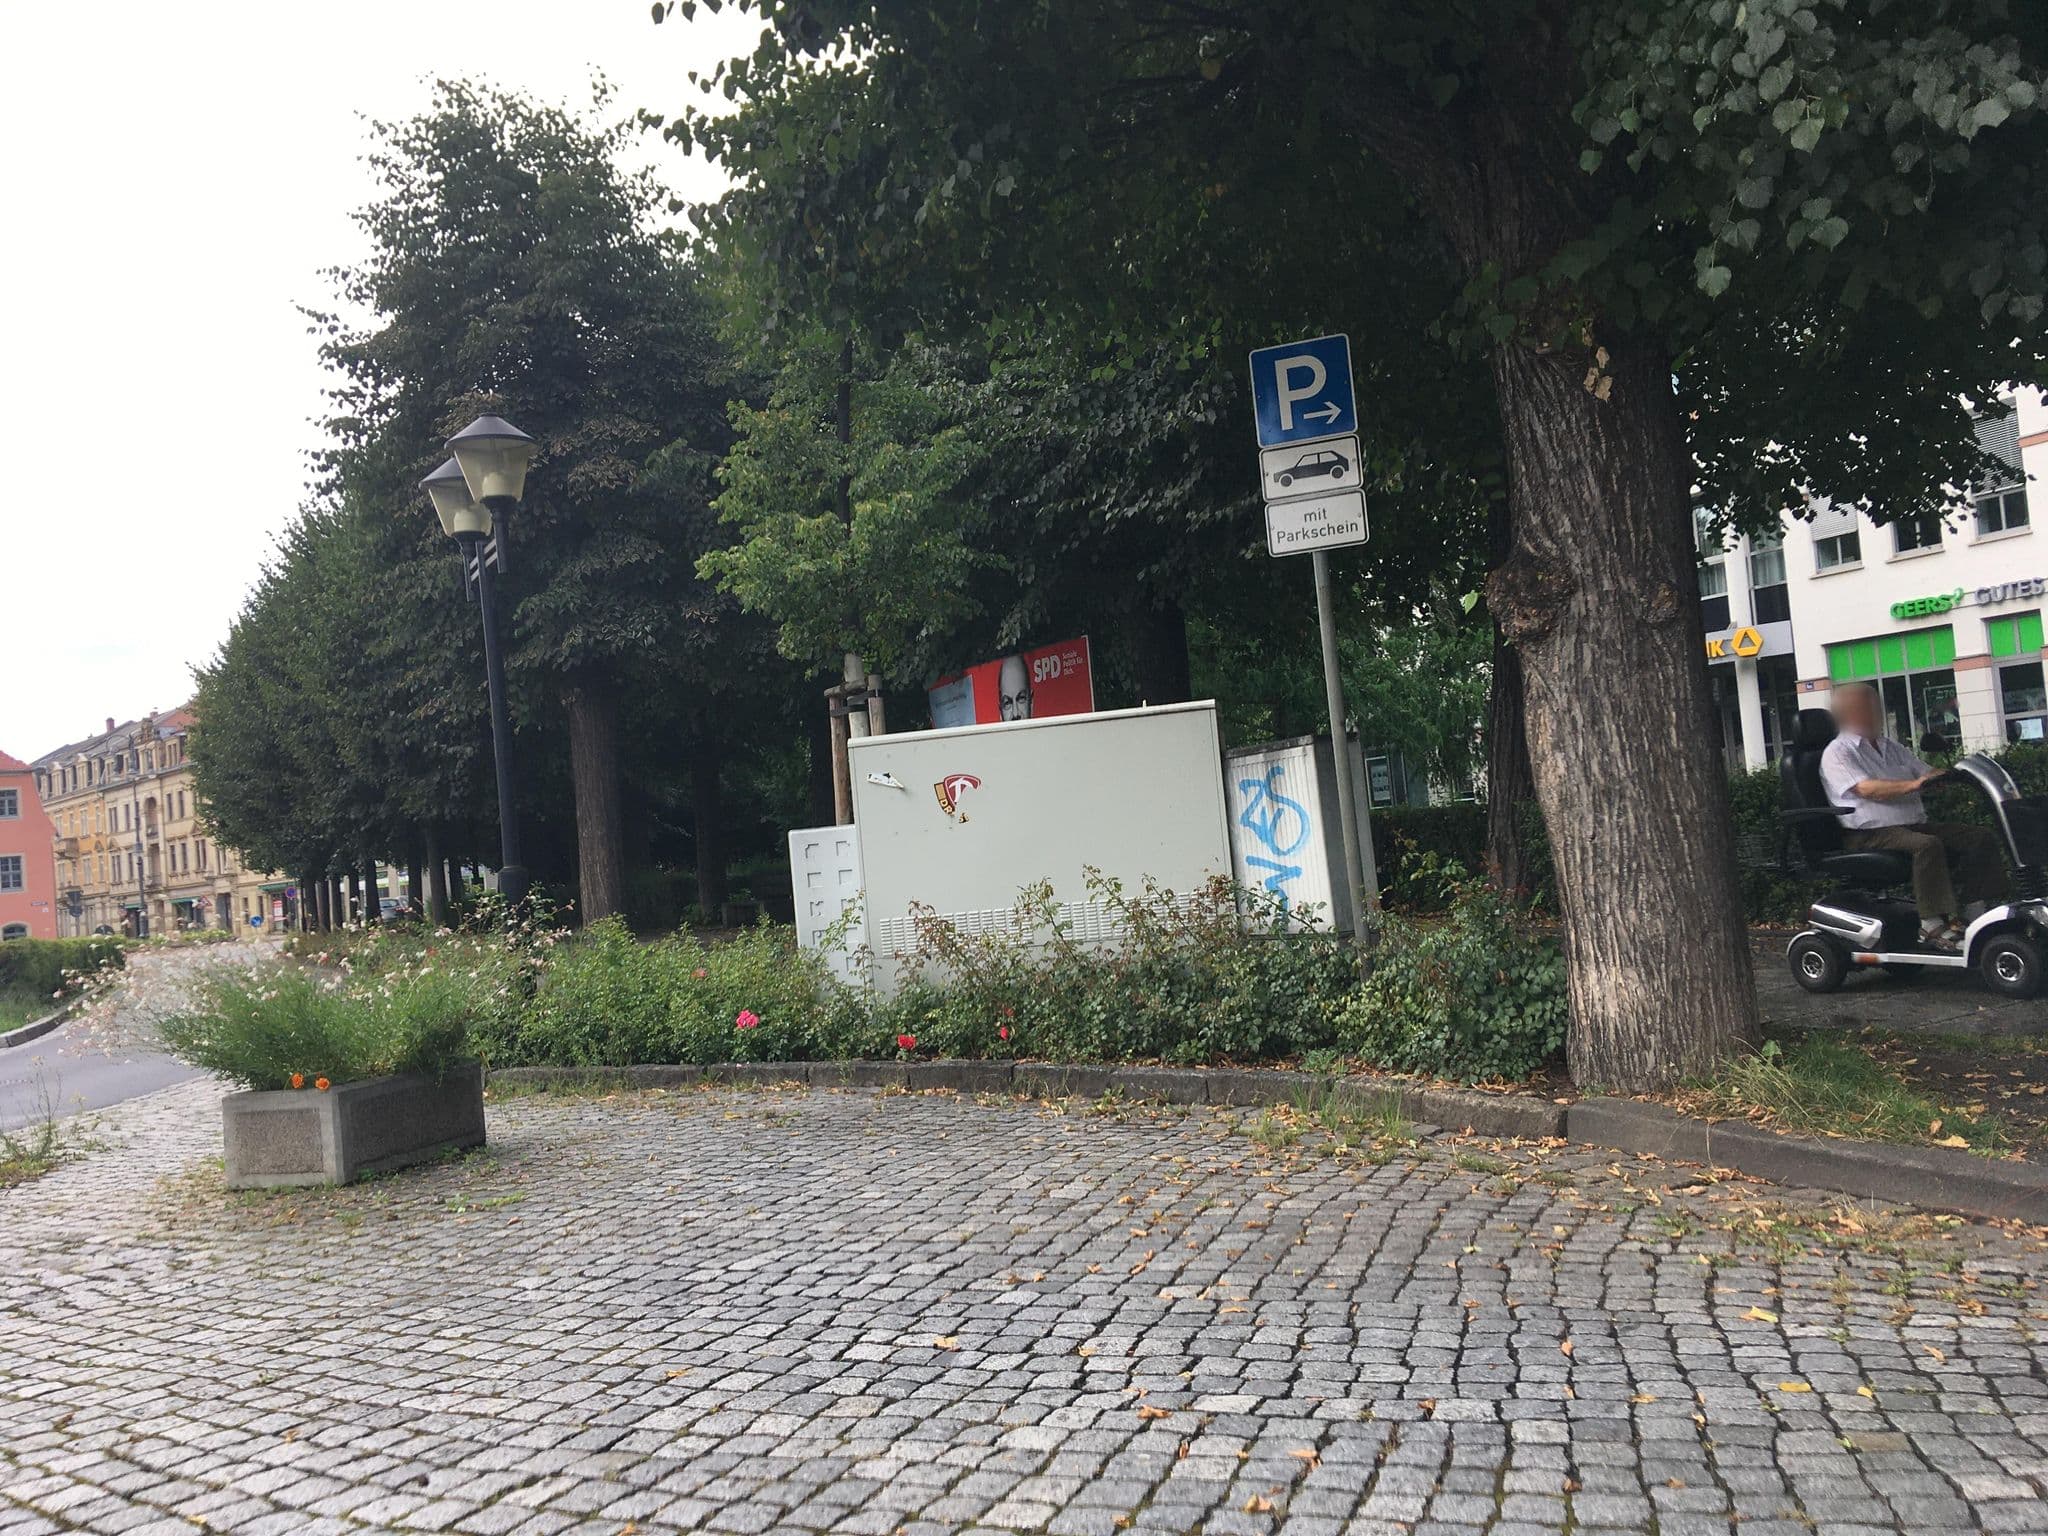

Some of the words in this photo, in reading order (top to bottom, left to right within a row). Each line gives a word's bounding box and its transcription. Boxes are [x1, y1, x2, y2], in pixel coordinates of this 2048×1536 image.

[1274, 355, 1327, 431] P
[1303, 507, 1327, 524] mit
[1277, 520, 1359, 544] Parkschein
[1890, 594, 1953, 619] GEERS
[1974, 577, 2046, 606] GUTES
[1033, 654, 1061, 683] SPD
